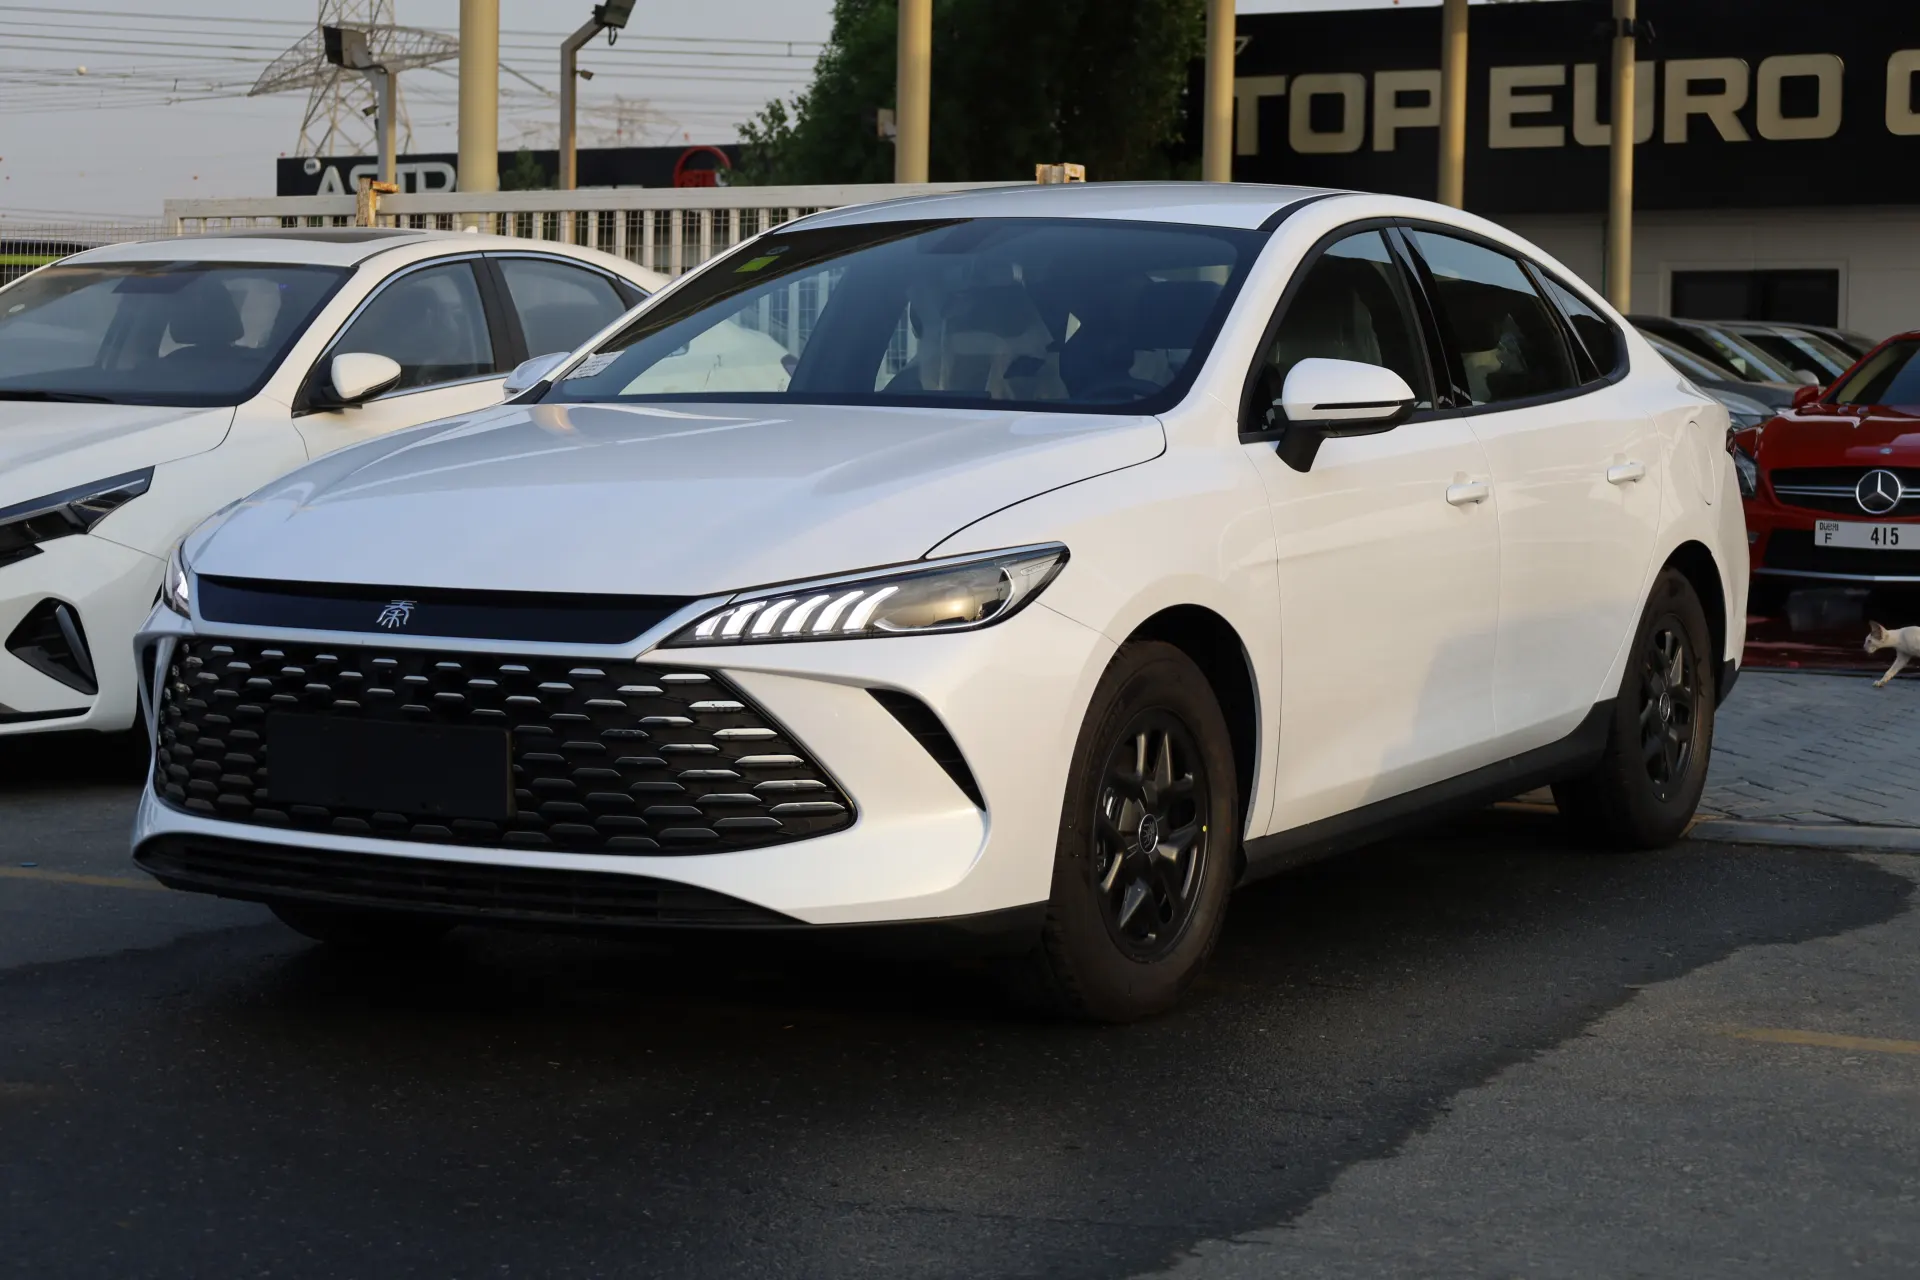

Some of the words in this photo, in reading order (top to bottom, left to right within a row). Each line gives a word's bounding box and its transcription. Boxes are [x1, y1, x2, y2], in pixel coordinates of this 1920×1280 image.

[1234, 70, 1442, 156] TOP
[1488, 53, 1844, 149] EURO
[1824, 532, 1833, 544] F
[1870, 527, 1899, 546] 415
